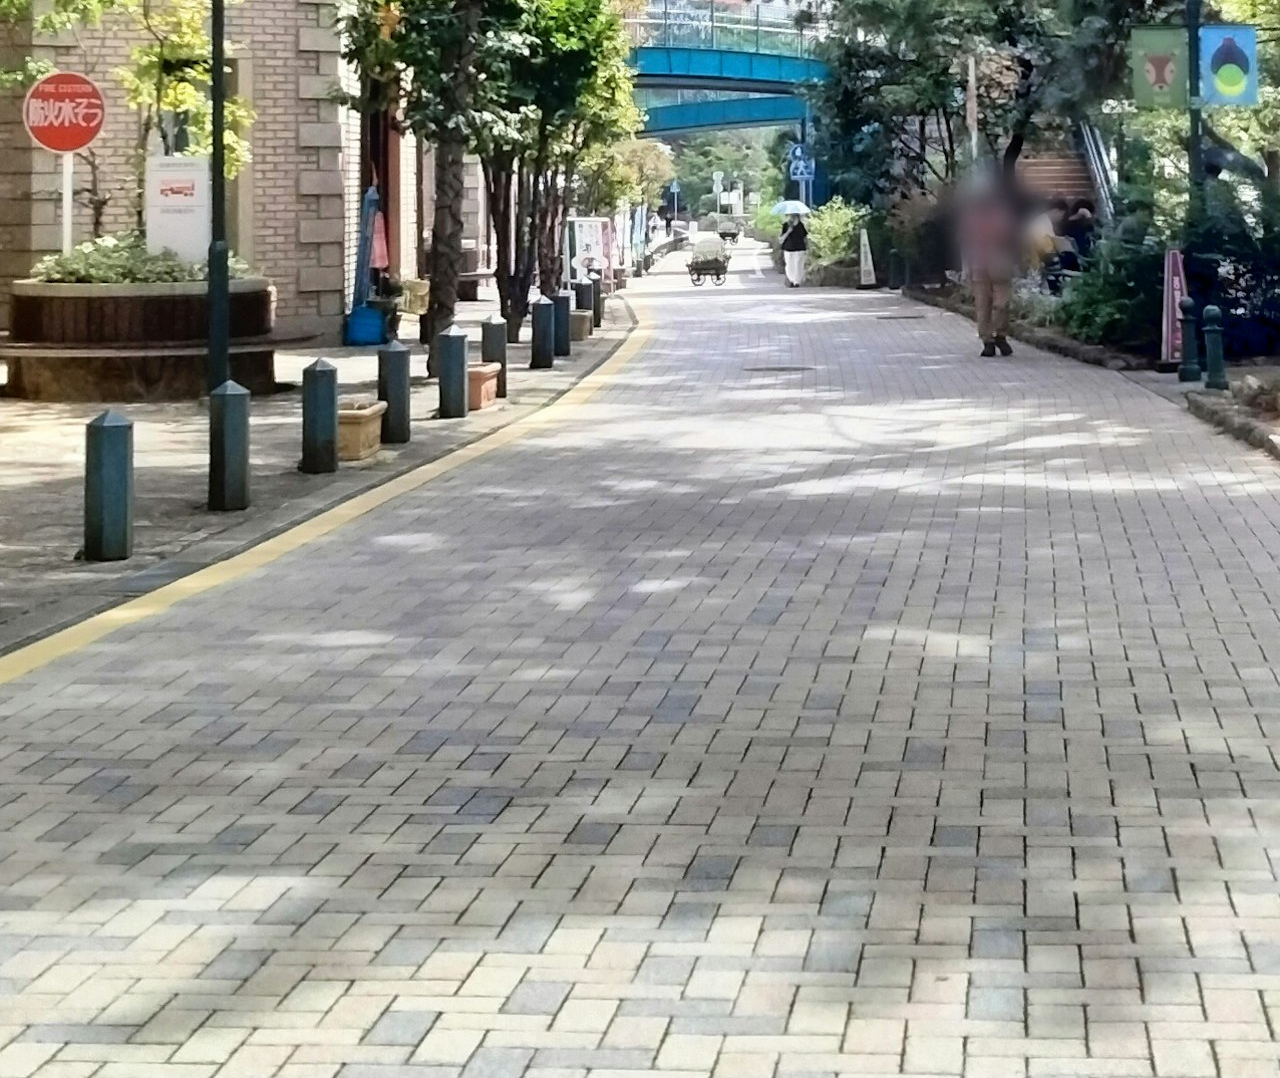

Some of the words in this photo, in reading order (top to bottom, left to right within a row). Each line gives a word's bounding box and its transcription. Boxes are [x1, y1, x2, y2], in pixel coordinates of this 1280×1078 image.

[38, 84, 56, 93] FIRE
[58, 84, 93, 93] CISTERN
[28, 98, 103, 127] 防火水そう
